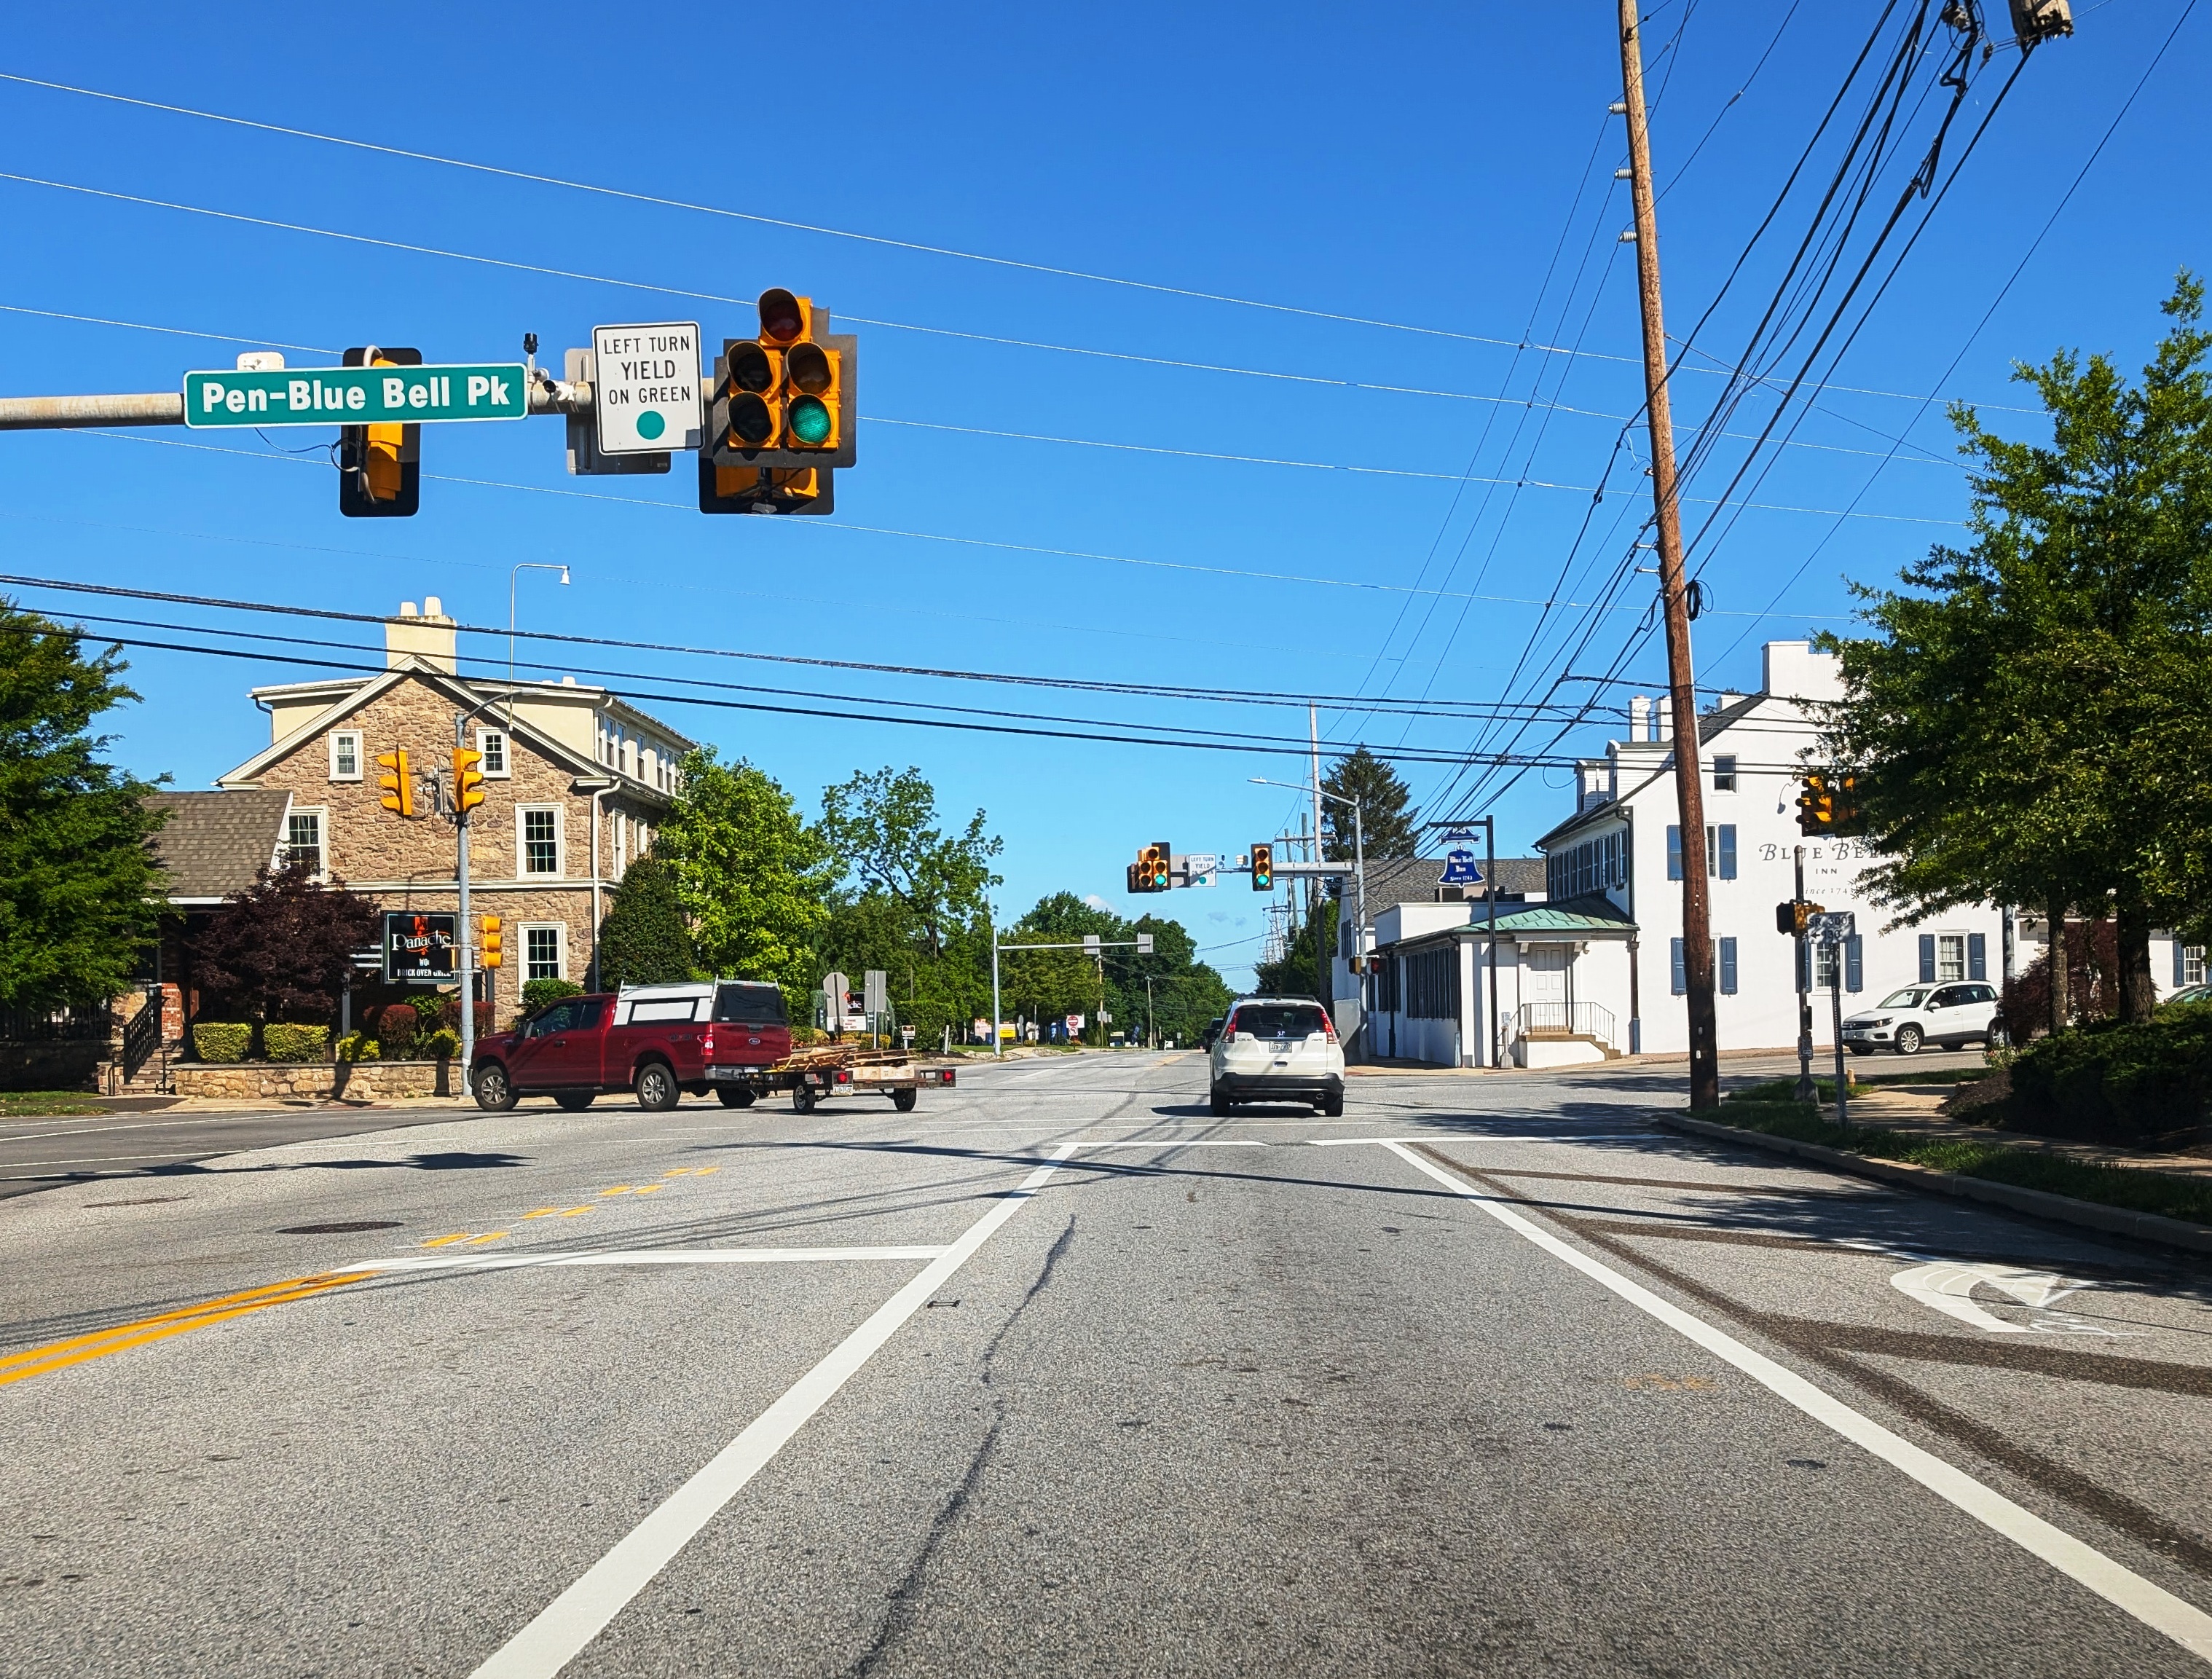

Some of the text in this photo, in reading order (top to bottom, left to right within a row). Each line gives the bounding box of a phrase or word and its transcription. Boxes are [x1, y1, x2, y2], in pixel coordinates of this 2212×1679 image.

[604, 336, 690, 354] LEFT TURN
[621, 360, 675, 380] YIELD
[202, 375, 510, 412] Pen-Blue Bell Pk
[609, 386, 690, 405] ON GREEN
[1805, 886, 1851, 895] ince 174
[1808, 918, 1821, 927] SR
[391, 929, 452, 951] Panache
[397, 969, 416, 977] BRICK
[416, 969, 432, 977] OVEN
